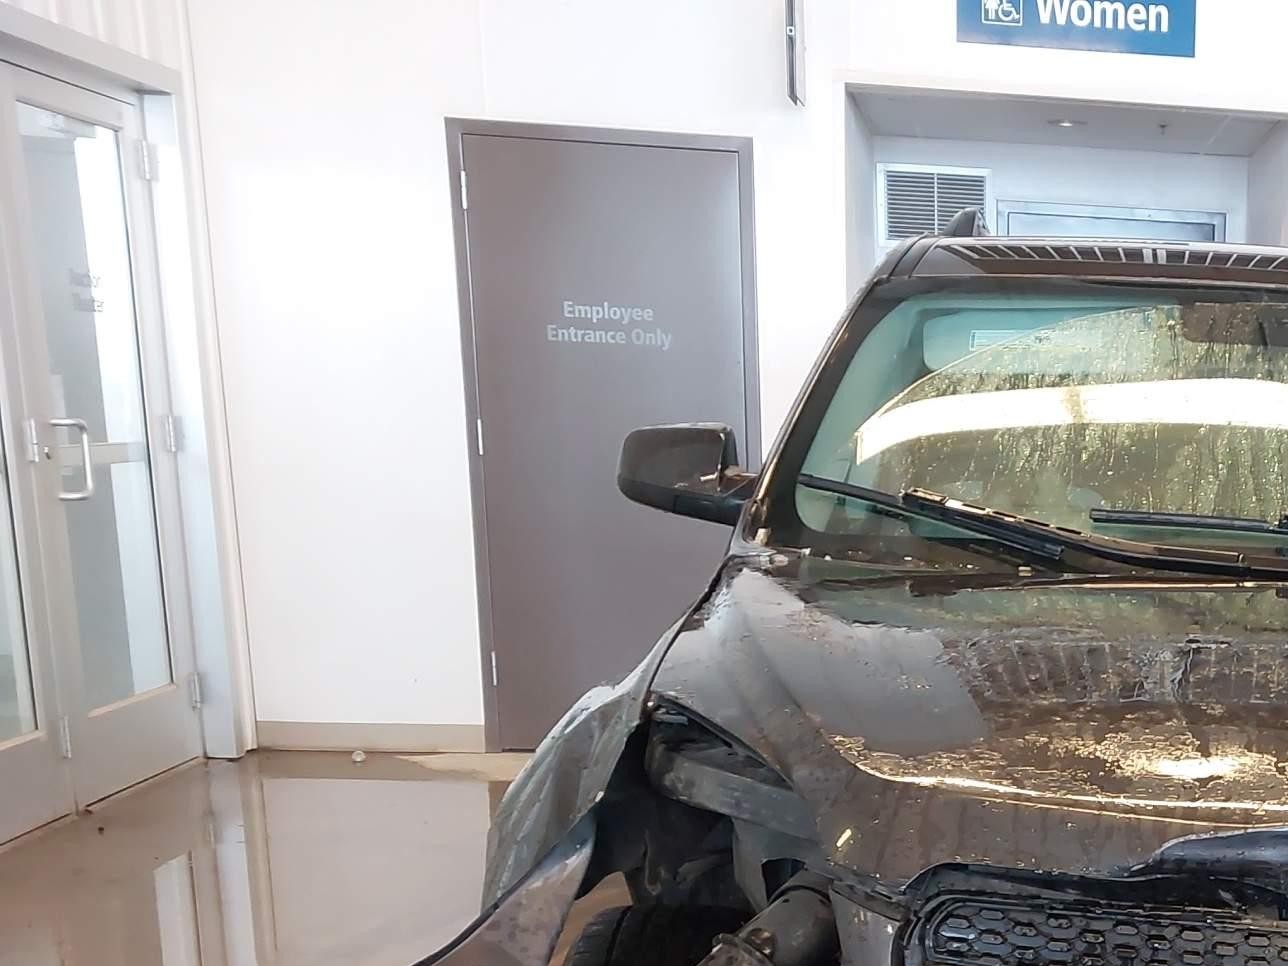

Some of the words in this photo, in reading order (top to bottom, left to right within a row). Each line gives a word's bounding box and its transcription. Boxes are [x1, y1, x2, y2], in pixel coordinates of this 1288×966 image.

[1036, 0, 1169, 33] Women
[563, 301, 654, 324] Employee
[547, 325, 626, 344] Entrance
[631, 329, 672, 350] Only
